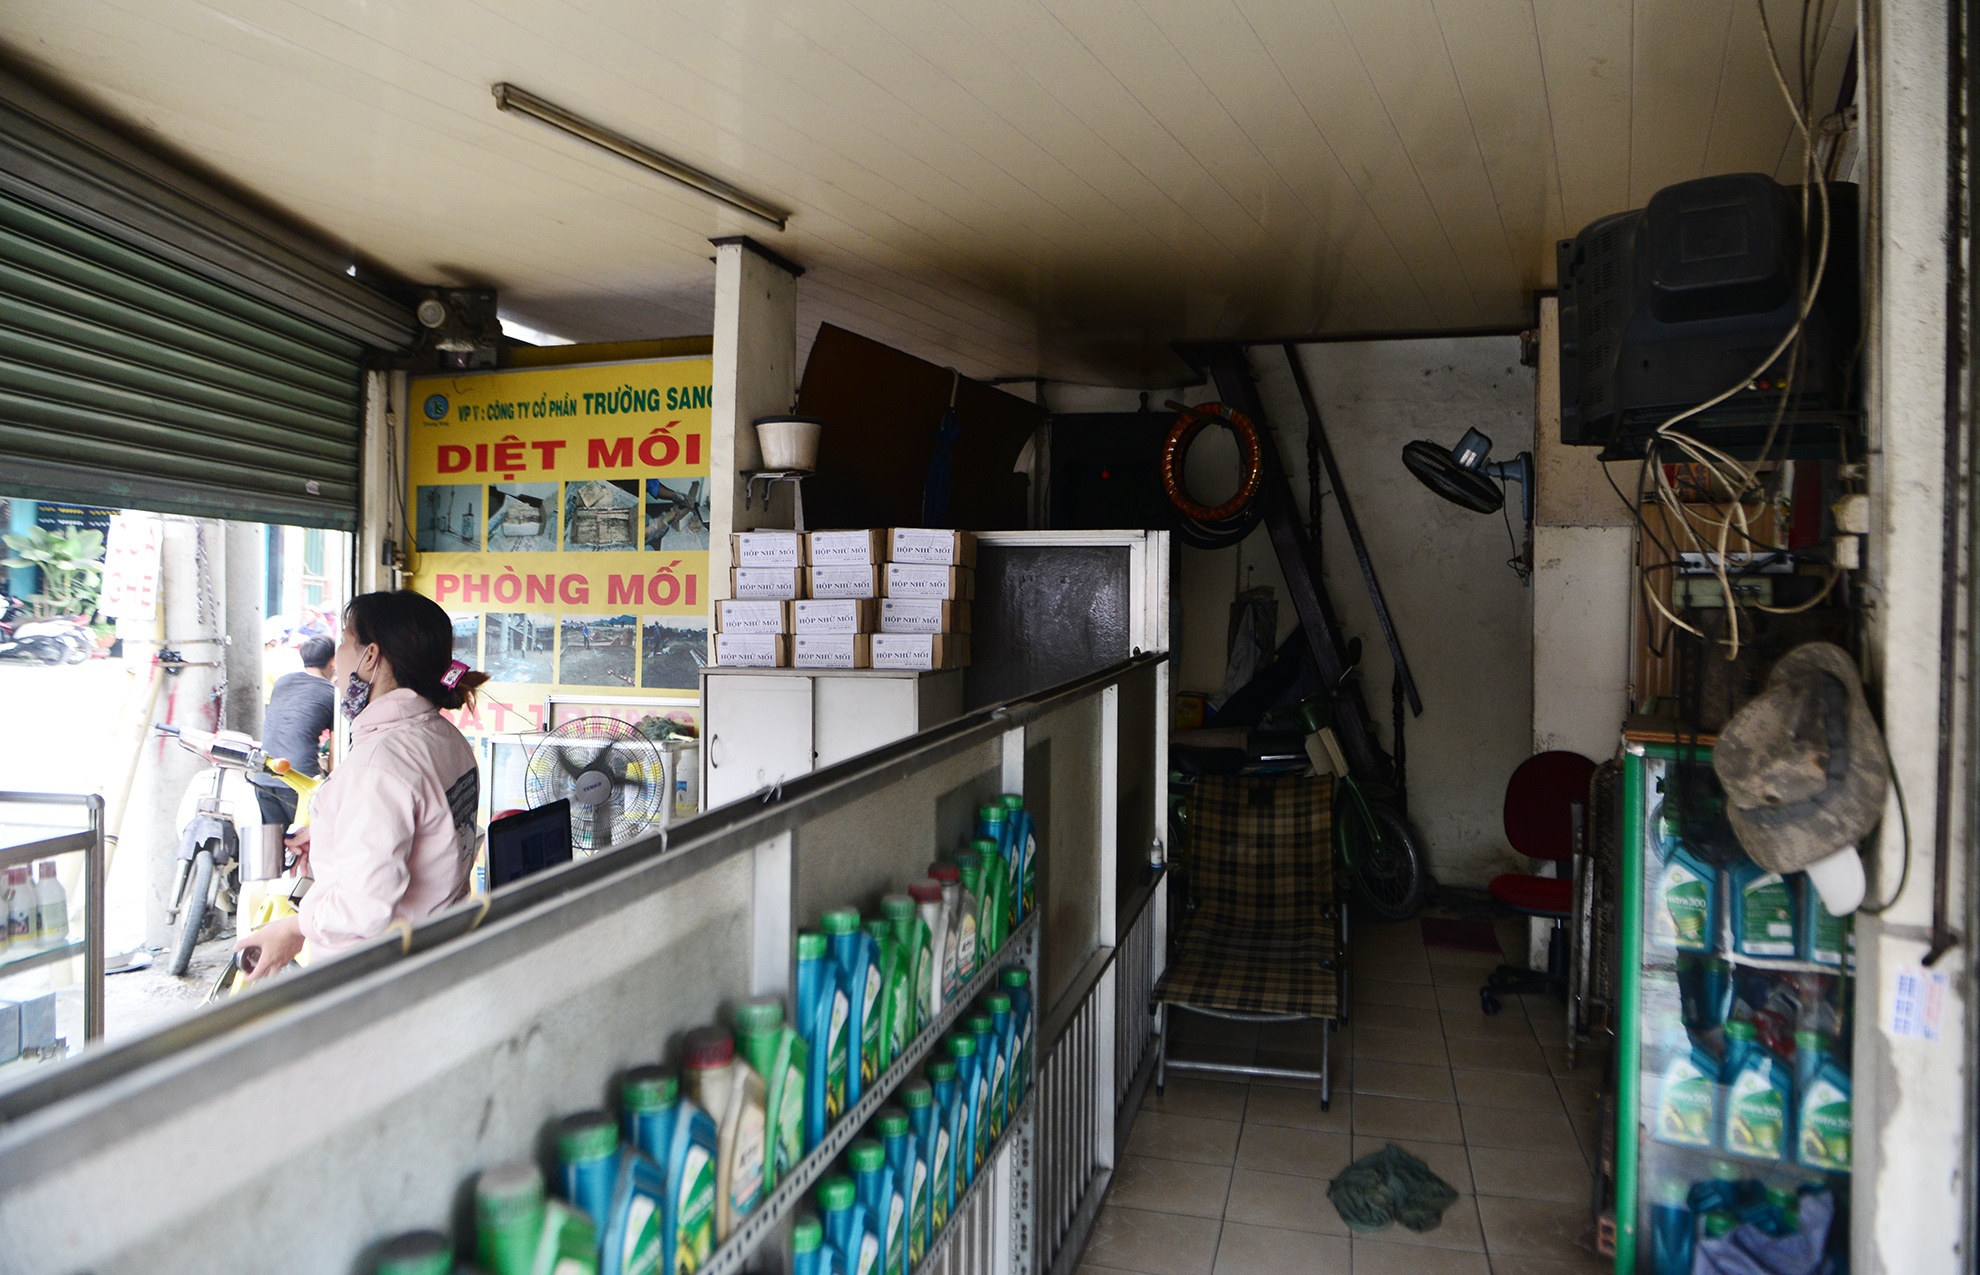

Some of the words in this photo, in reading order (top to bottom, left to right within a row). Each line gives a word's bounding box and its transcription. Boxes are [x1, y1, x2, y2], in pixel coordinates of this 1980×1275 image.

[487, 400, 515, 422] CÔNG
[517, 402, 530, 419] TY
[549, 392, 577, 417] PHẦN
[583, 384, 660, 415] TRƯỜNG
[437, 434, 567, 481] DIỆT
[587, 420, 701, 469] MỐI
[743, 549, 760, 557] HỘP
[815, 548, 831, 556] HỘP
[896, 545, 913, 553] HỘP
[435, 565, 590, 605] PHÒNG
[607, 560, 698, 606] MỐI
[740, 582, 757, 590] HỘP
[816, 582, 833, 590] HỘP
[891, 580, 908, 588] HỘP
[799, 617, 816, 625] HỘP
[885, 615, 902, 623] HỘP
[726, 620, 742, 628] HỘP
[720, 653, 737, 661] HỘP
[798, 652, 814, 661] HỘP
[876, 651, 893, 659] HỘP
